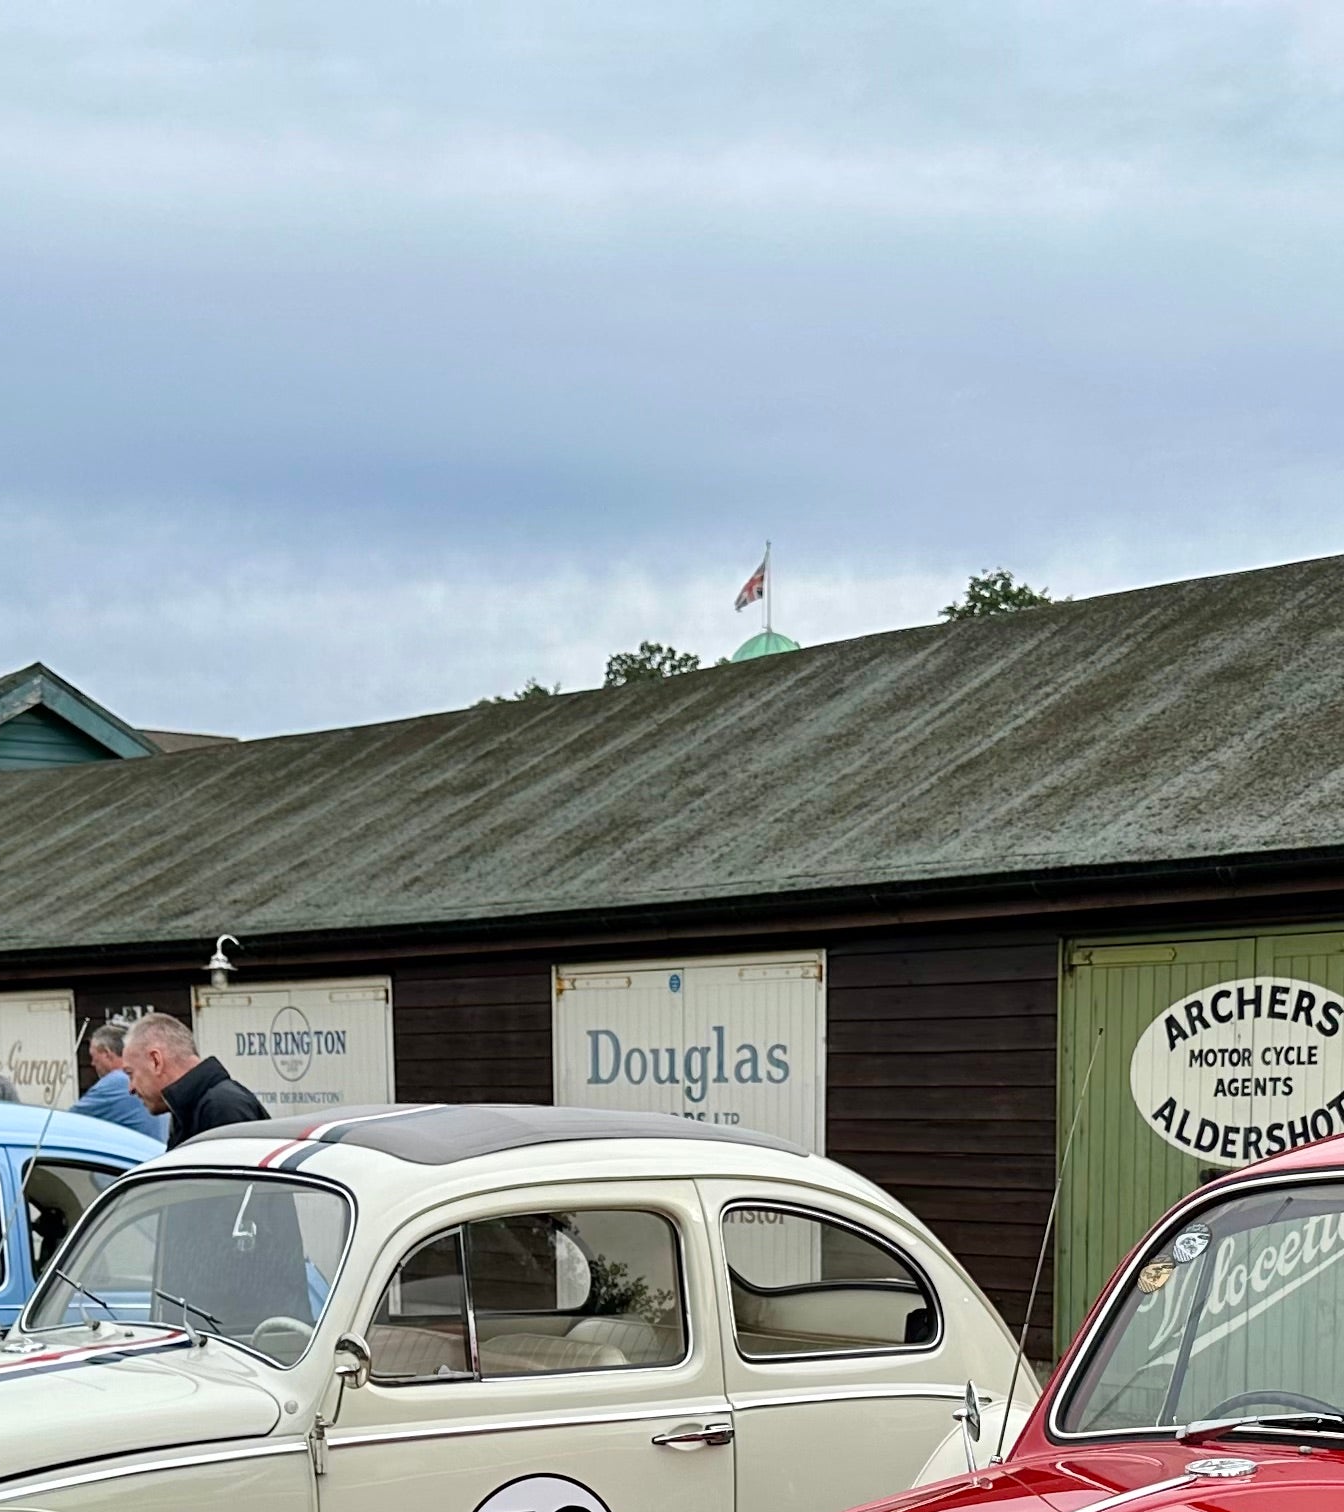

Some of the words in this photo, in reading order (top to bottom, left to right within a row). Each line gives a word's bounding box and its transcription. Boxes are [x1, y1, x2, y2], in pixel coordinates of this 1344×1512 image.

[1164, 985, 1344, 1051] ARCHERS
[8, 1040, 71, 1104] Garage
[586, 1025, 791, 1103] Douglas
[1188, 1048, 1252, 1068] MOTOR
[1261, 1045, 1318, 1066] CYCLE
[1213, 1077, 1293, 1097] AGENTS
